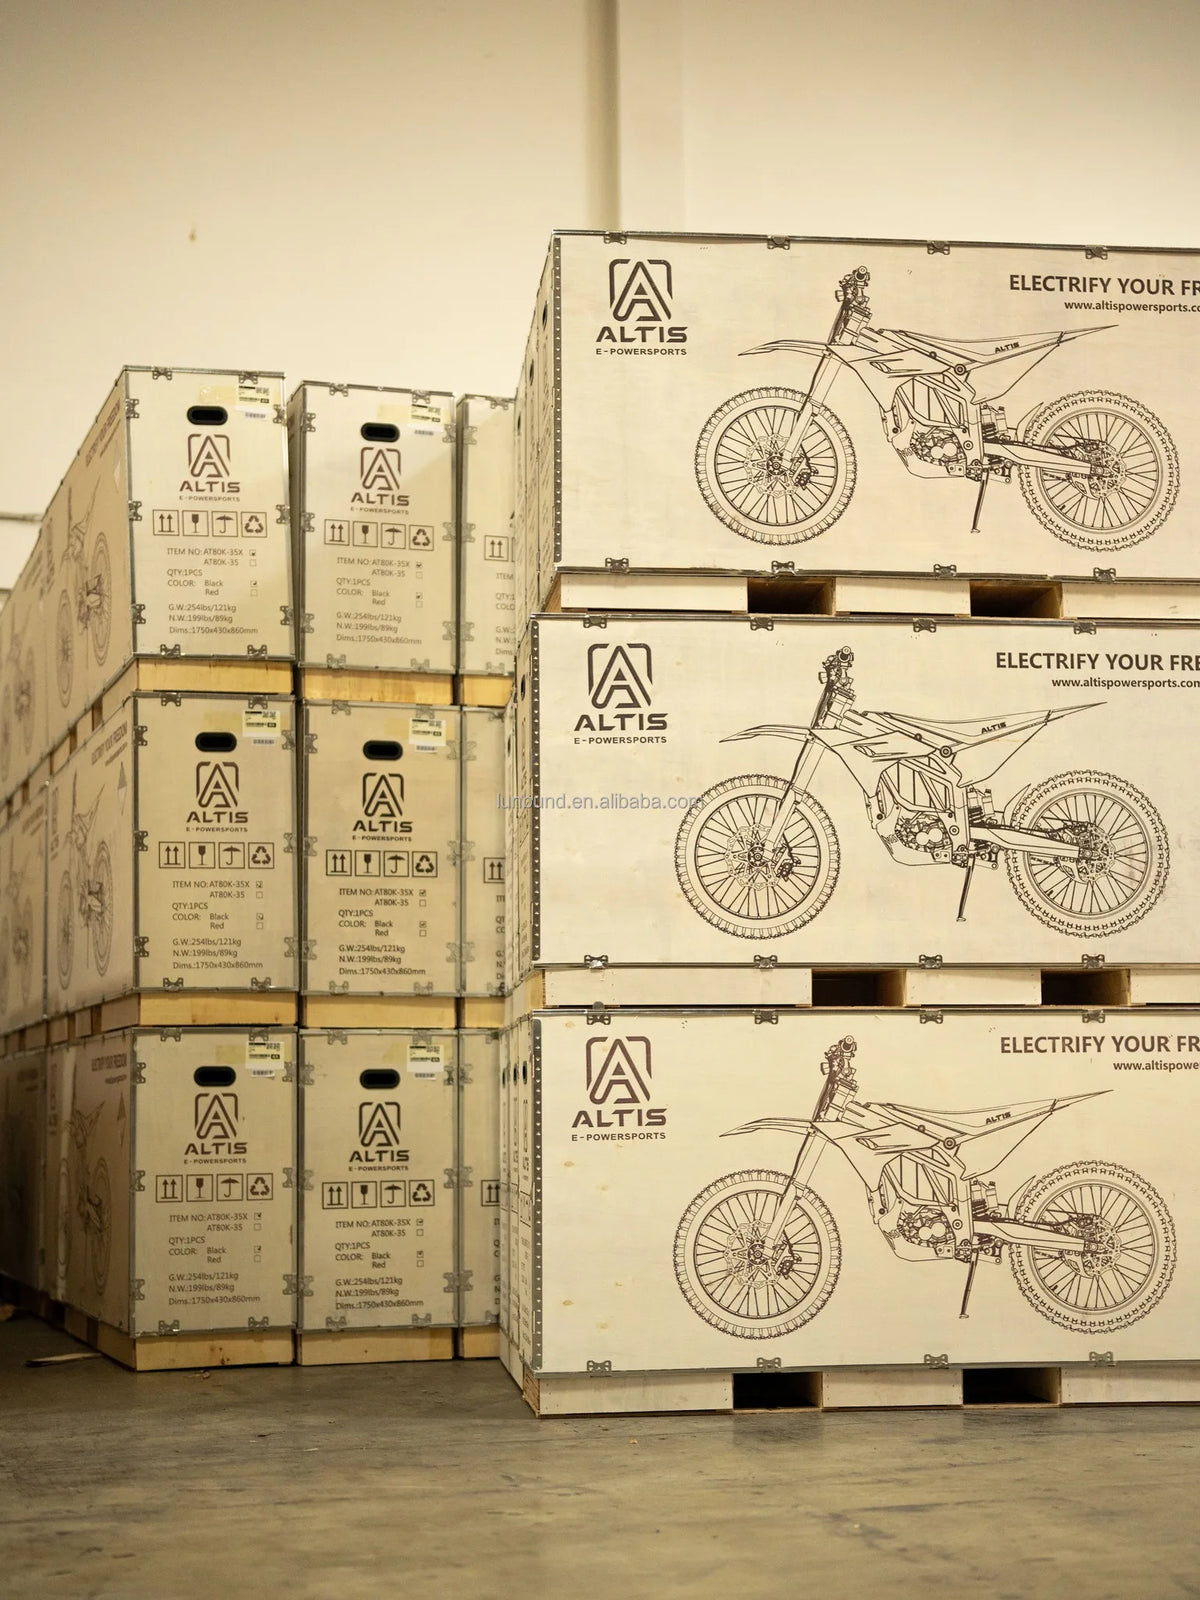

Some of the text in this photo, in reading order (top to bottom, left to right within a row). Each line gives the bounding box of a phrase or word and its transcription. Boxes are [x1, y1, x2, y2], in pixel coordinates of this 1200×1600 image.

[1009, 274, 1112, 293] ELECTRIFY
[1117, 277, 1176, 295] YOUR
[595, 325, 689, 343] ALTIS
[179, 480, 241, 493] ALTIS
[351, 492, 410, 506] ALTIS
[167, 547, 186, 555] ITEM
[996, 652, 1099, 669] ELECTRIFY
[1105, 653, 1164, 671] YOUR
[573, 712, 668, 732] ALTIS
[186, 811, 249, 824] ALTIS
[352, 819, 413, 833] ALTIS
[172, 880, 191, 888] ITEM
[339, 888, 358, 896] ITEM
[209, 912, 229, 921] Black
[210, 921, 225, 930] Red
[374, 919, 393, 928] Black
[375, 928, 389, 937] Red
[1000, 1035, 1200, 1054] ELECTRIFY YOUR FR
[571, 1108, 667, 1128] ALTIS
[184, 1142, 248, 1156] ALTIS
[349, 1149, 411, 1163] ALTIS
[169, 1214, 189, 1223] ITEM
[335, 1221, 354, 1229] ITEM
[206, 1246, 227, 1254] Black
[371, 1252, 391, 1260] Black
[371, 1261, 386, 1269] Red
